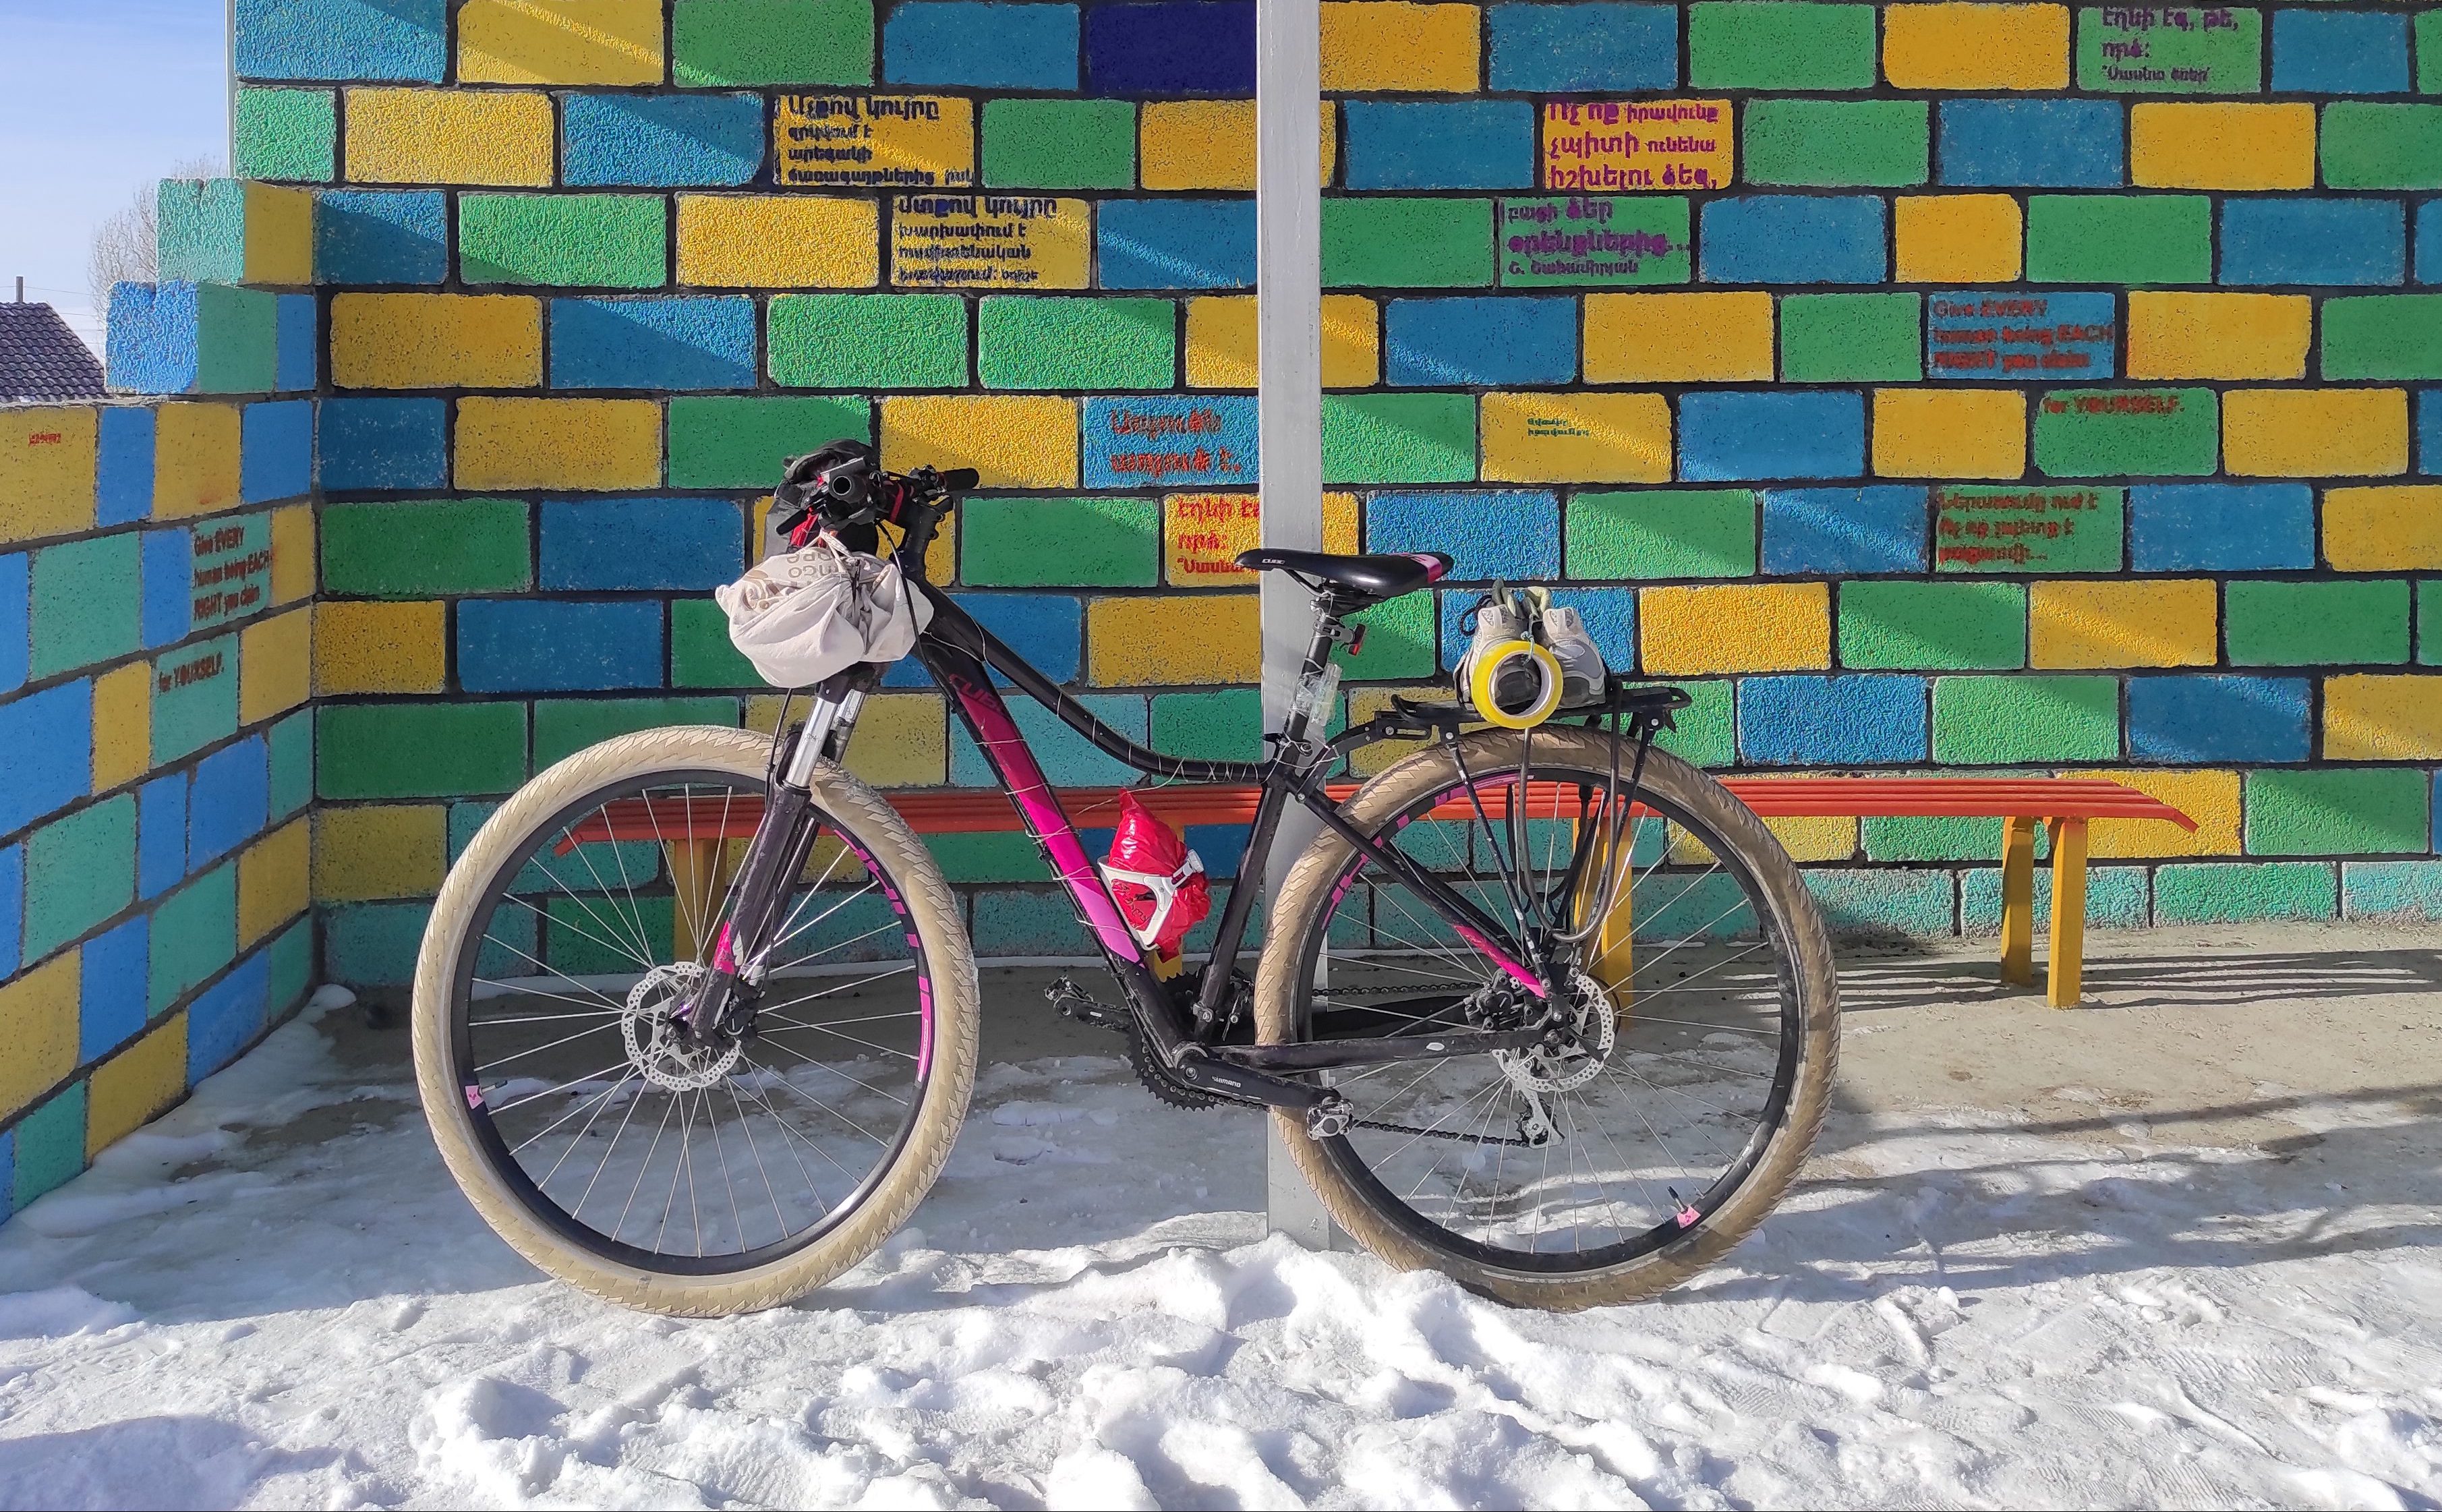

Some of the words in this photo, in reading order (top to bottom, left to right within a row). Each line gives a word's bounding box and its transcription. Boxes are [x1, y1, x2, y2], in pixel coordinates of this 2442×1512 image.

[1550, 102, 1581, 127] Ոչ
[1588, 103, 1620, 126] ոք
[1627, 104, 1720, 123] իրավունք
[1550, 131, 1640, 159] չպիտի
[1646, 136, 1717, 152] ունենա
[1550, 163, 1654, 192] իշխելու
[1211, 1075, 1242, 1088] SHIMANO
